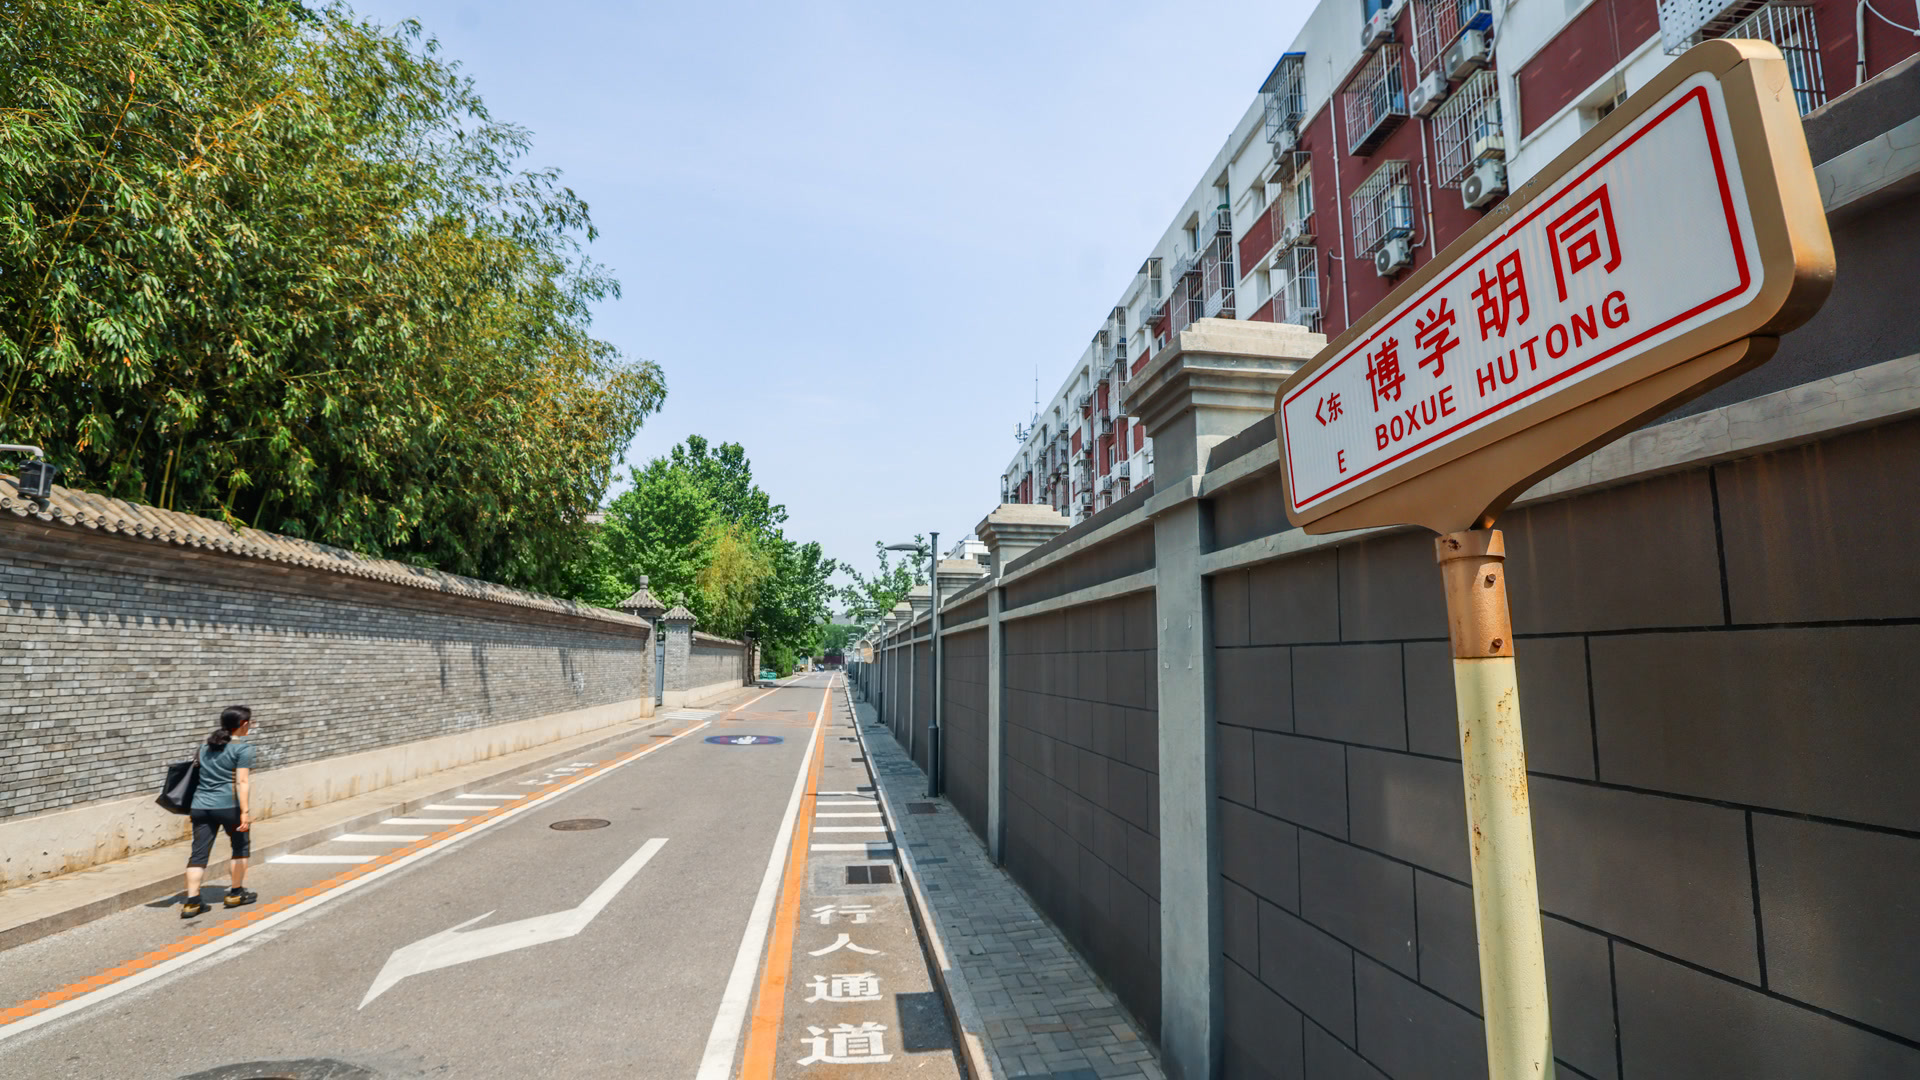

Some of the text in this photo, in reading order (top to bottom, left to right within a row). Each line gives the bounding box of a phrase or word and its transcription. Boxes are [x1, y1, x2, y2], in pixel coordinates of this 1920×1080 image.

[1366, 183, 1622, 412] 博学胡同
[1376, 290, 1630, 451] BOXUE HUTONG
[1327, 393, 1343, 423] 东
[1337, 449, 1347, 474] E
[797, 904, 893, 1066] 行人通道
